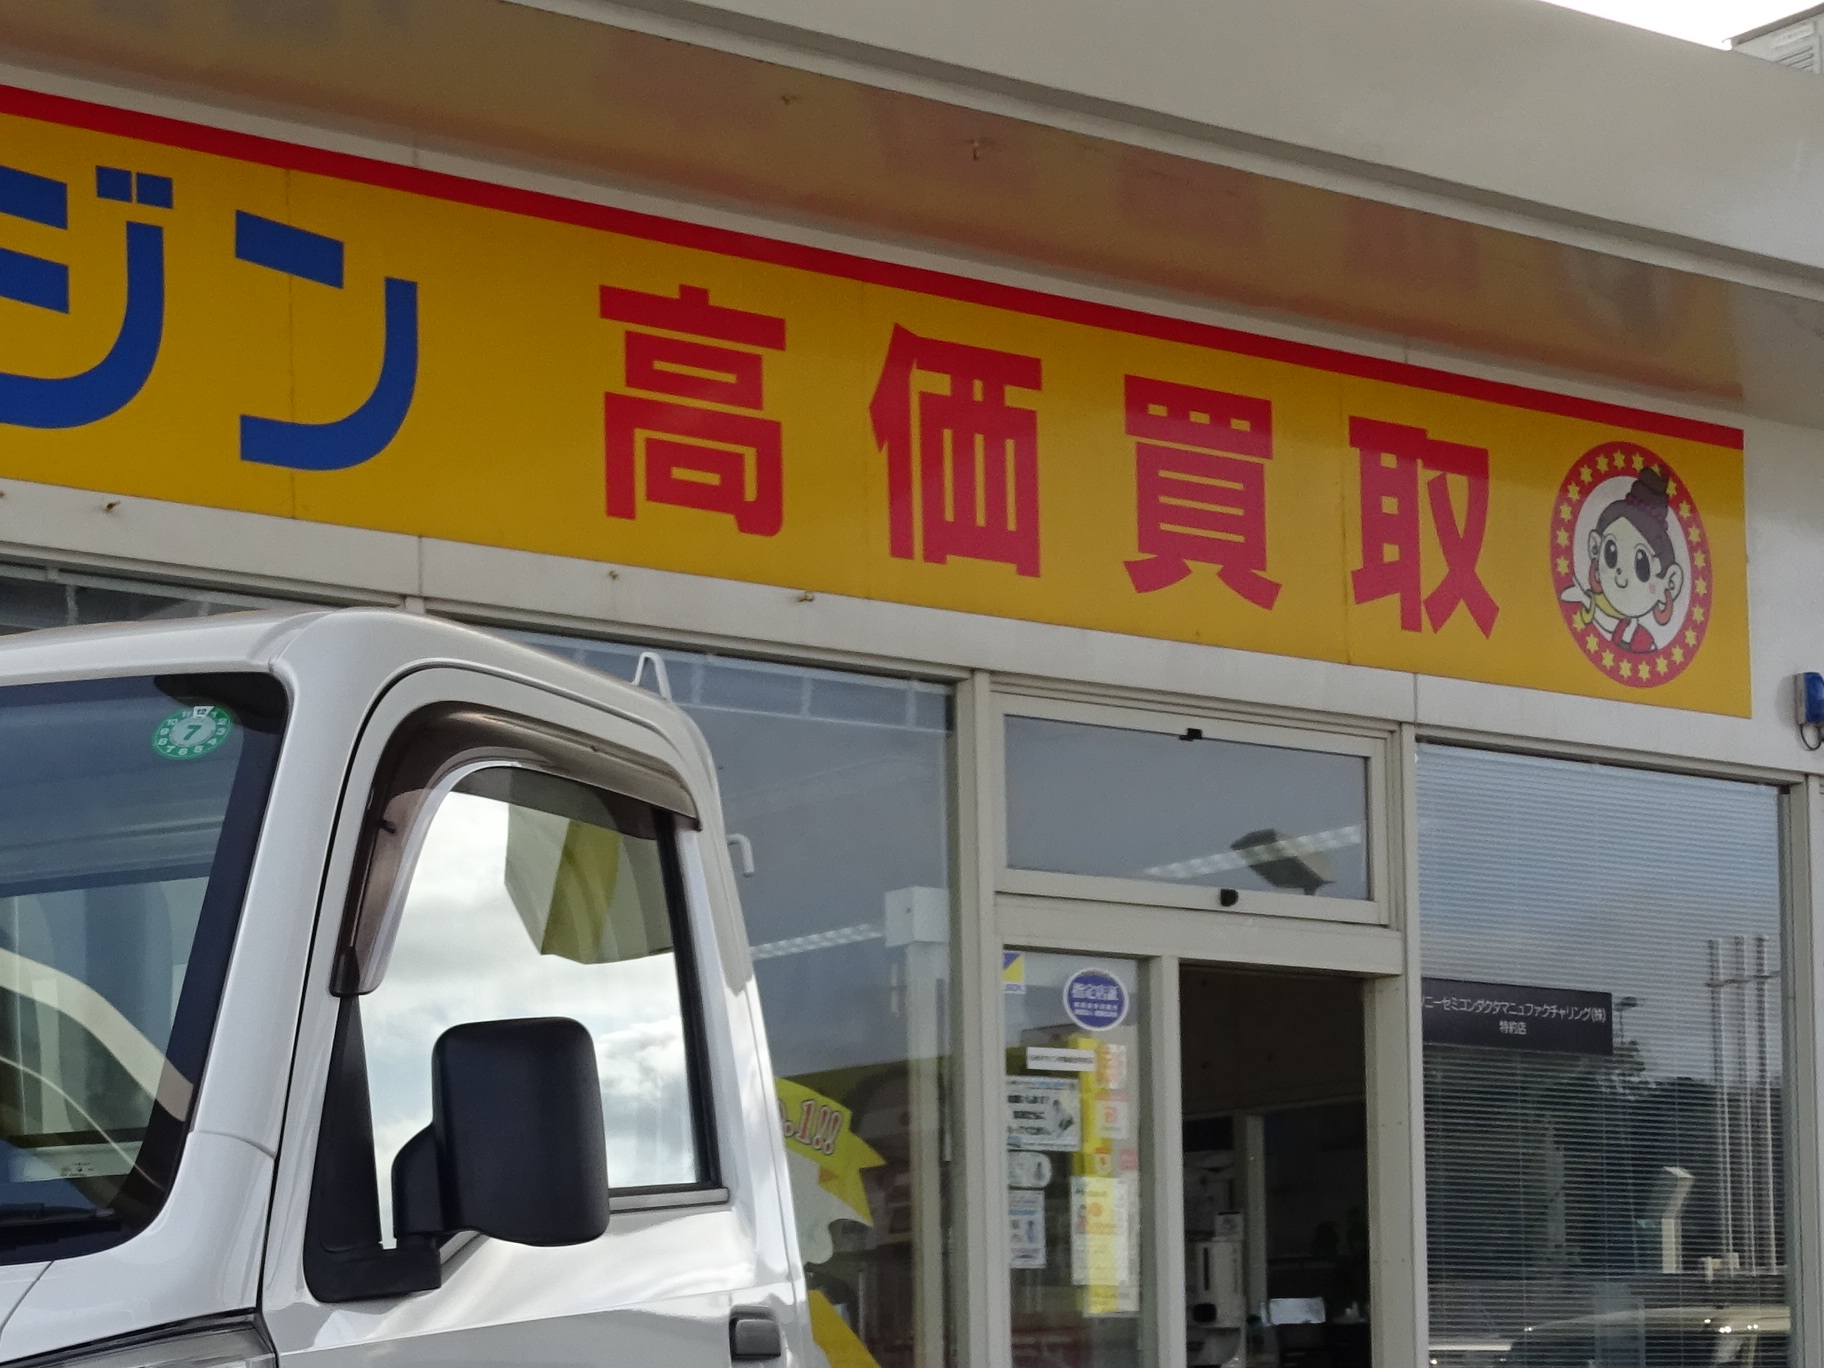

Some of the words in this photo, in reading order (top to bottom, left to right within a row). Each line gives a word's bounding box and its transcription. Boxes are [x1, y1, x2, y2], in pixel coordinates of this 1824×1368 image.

[599, 284, 1500, 641] 高価買取
[183, 724, 203, 741] 7
[1421, 995, 1608, 1024] ニーセミコンダクタマニュファクチャリング(株)
[1499, 1019, 1527, 1036] 特約店
[778, 1099, 843, 1156] .1!!
